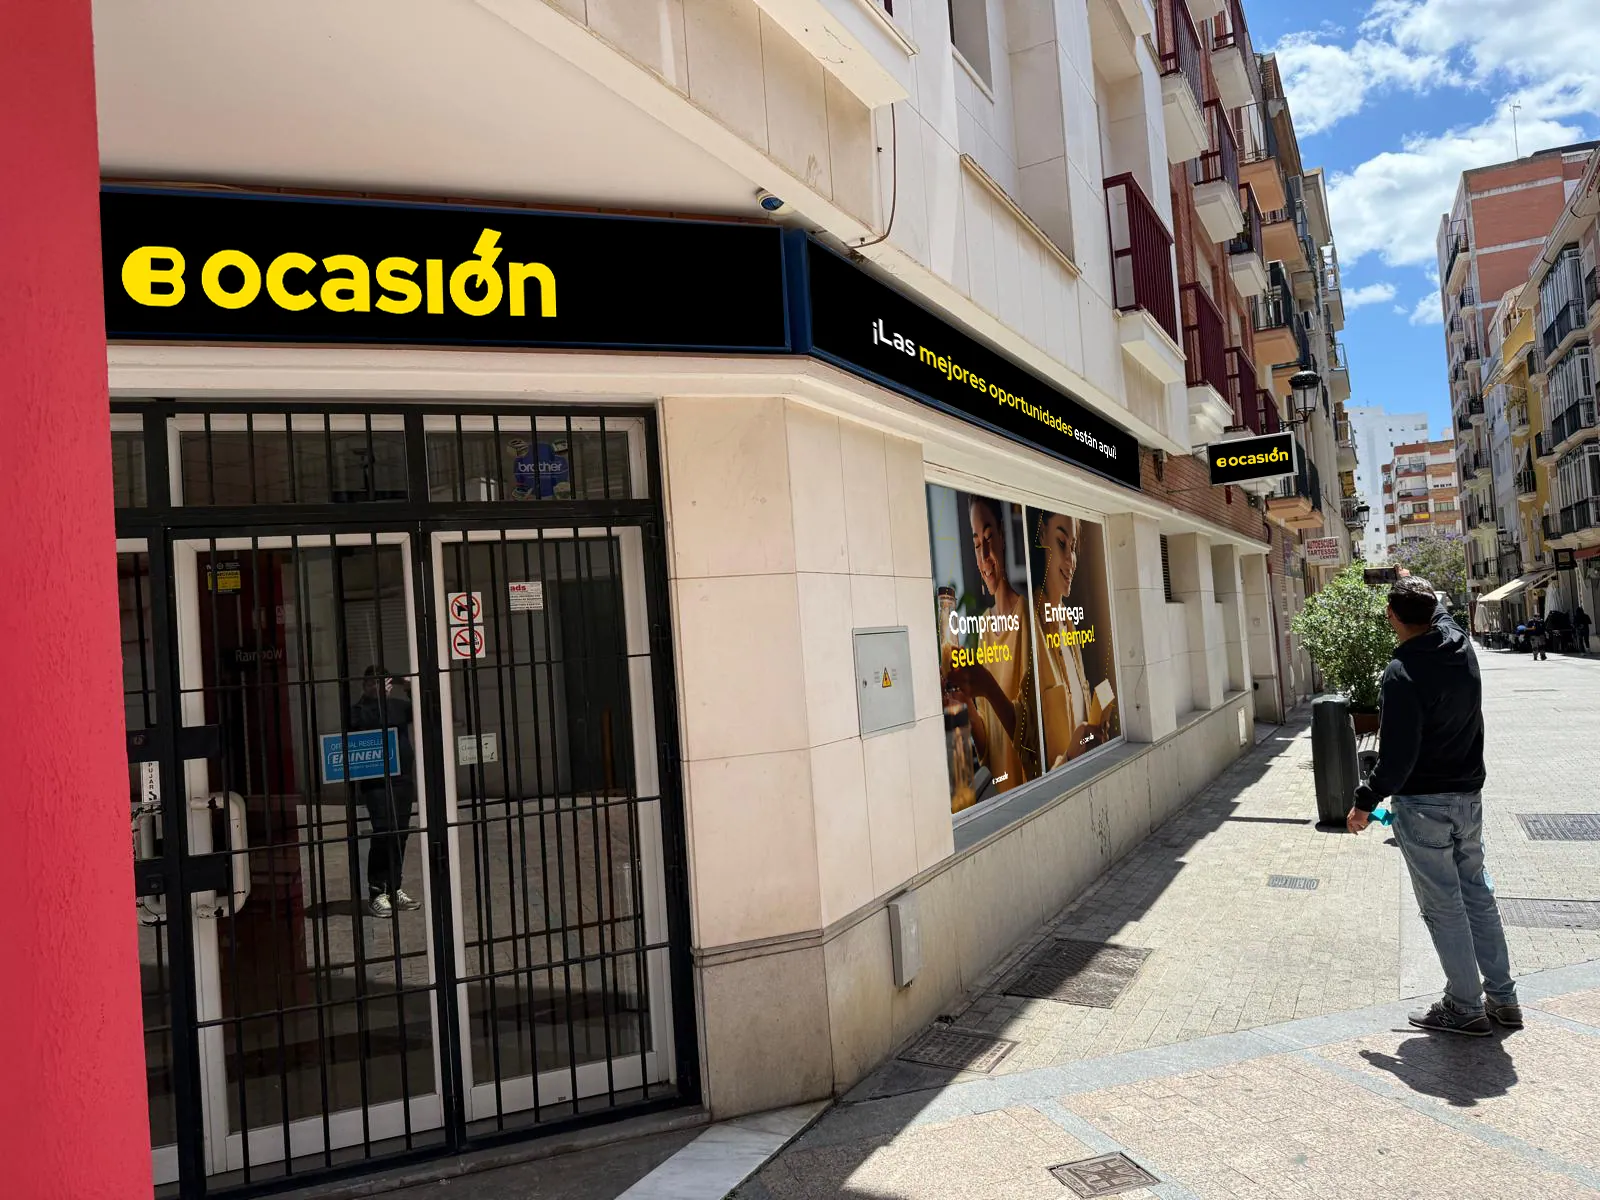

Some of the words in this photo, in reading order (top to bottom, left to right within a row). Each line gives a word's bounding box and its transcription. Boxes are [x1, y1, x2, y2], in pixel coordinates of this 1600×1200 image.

[201, 228, 557, 317] ocasión
[872, 318, 915, 356] ¡Las
[919, 345, 986, 393] mejores
[989, 383, 1073, 437] oportunidades
[1074, 428, 1098, 449] están
[1099, 440, 1117, 459] aquí!
[1228, 447, 1289, 466] ocasión
[1307, 548, 1339, 556] TARTESSOS
[510, 584, 527, 592] ads
[949, 610, 1020, 639] Compramos
[1044, 602, 1084, 625] Entrega
[1046, 632, 1060, 648] no
[1061, 625, 1096, 649] tempo!
[951, 648, 974, 668] seu
[976, 641, 1012, 665] eletro.
[331, 741, 358, 750] OFFAL
[359, 739, 383, 747] RESELL
[332, 749, 384, 764] EINEN
